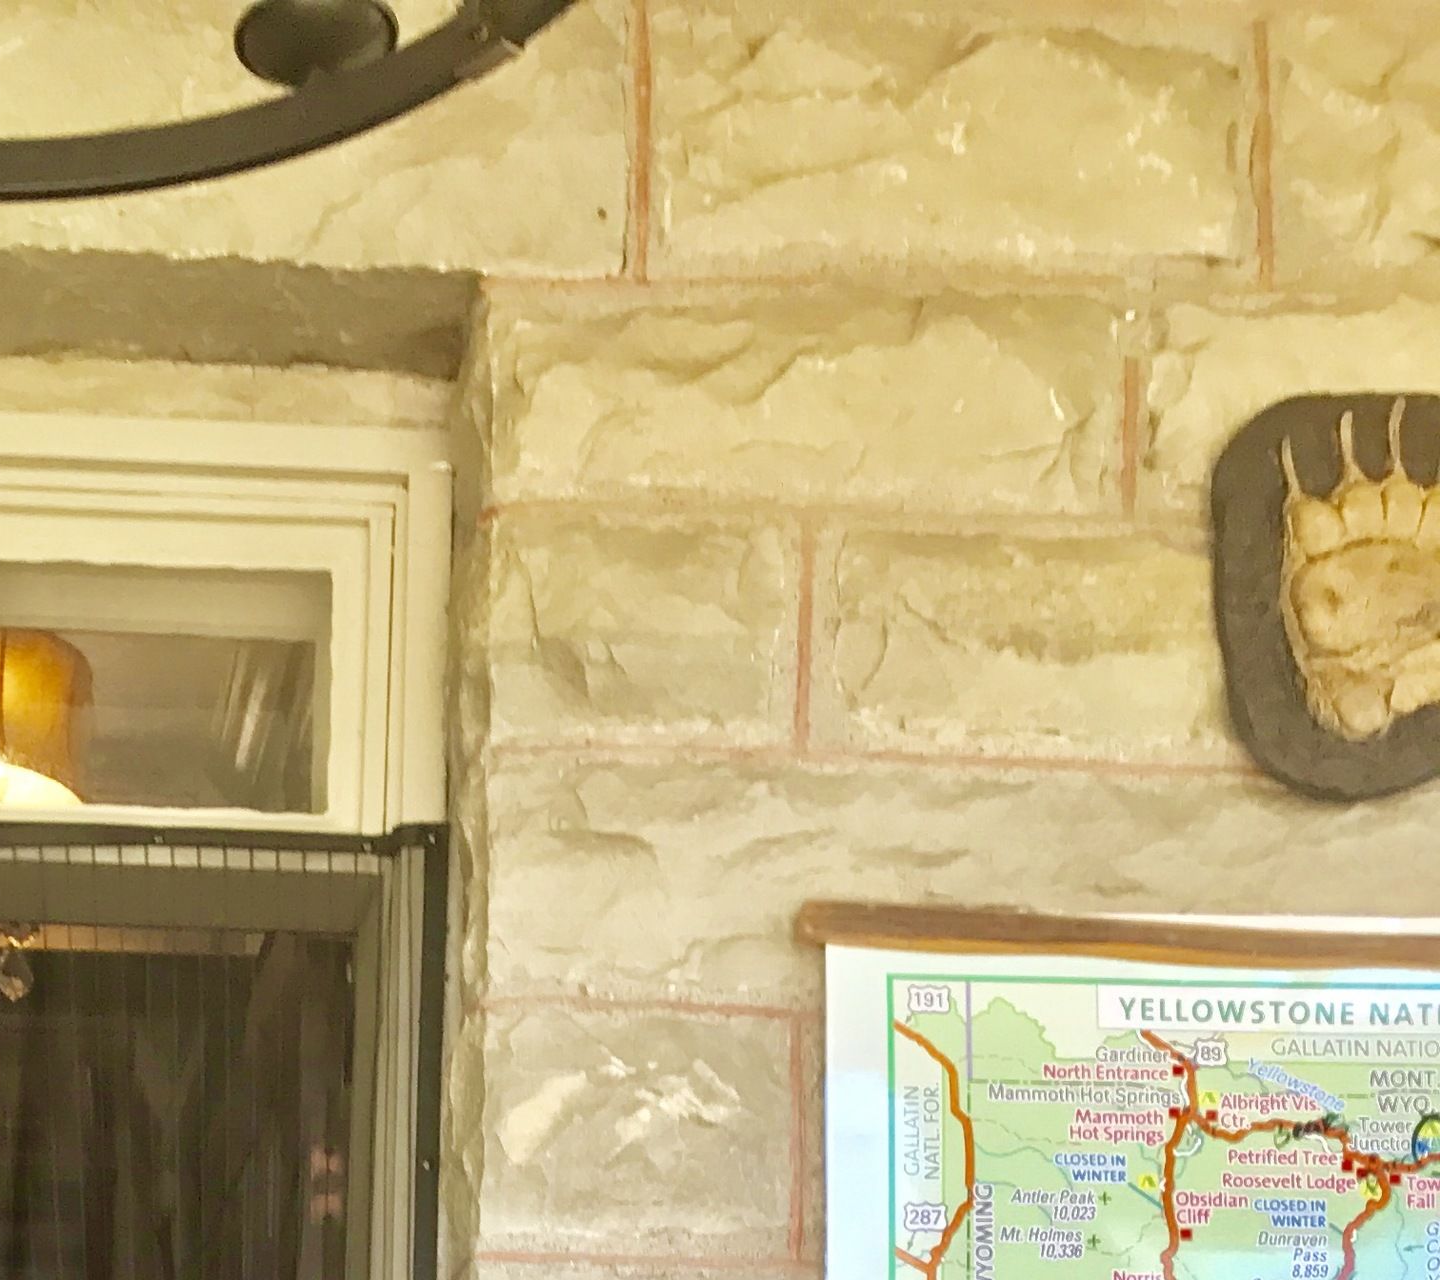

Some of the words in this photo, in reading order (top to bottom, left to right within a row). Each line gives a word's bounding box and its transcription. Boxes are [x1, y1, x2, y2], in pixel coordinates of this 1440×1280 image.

[1118, 998, 1354, 1027] YELLOWSTONE
[1095, 1047, 1170, 1063] Gardiner
[1271, 1039, 1369, 1057] GALLATIN
[1043, 1064, 1091, 1080] North
[1096, 1065, 1169, 1081] Entrance
[1221, 1095, 1288, 1114] Albright
[1075, 1109, 1164, 1125] Mammoth
[1070, 1126, 1101, 1141] Hot
[1104, 1126, 1165, 1146] Springs
[1054, 1153, 1107, 1167] CLOSED
[1111, 1154, 1126, 1167] IN
[1228, 1150, 1298, 1165] Petrified
[1303, 1151, 1338, 1165] Tree
[1072, 1169, 1126, 1182] WINTER
[1222, 1173, 1302, 1189] Roosevelt
[1307, 1174, 1356, 1193] Lodge
[1060, 1190, 1095, 1205] Peak
[1175, 1192, 1248, 1208] Obsidian
[1408, 1194, 1435, 1209] Fall
[1254, 1200, 1306, 1213] CLOSED
[1311, 1201, 1326, 1213] IN
[909, 1209, 942, 1224] 287
[1176, 1209, 1210, 1224] Cliff
[1271, 1215, 1326, 1228] WINTER
[1029, 1227, 1082, 1242] Holmes
[1040, 1244, 1083, 1259] 10,336
[1293, 1249, 1327, 1262] Pass
